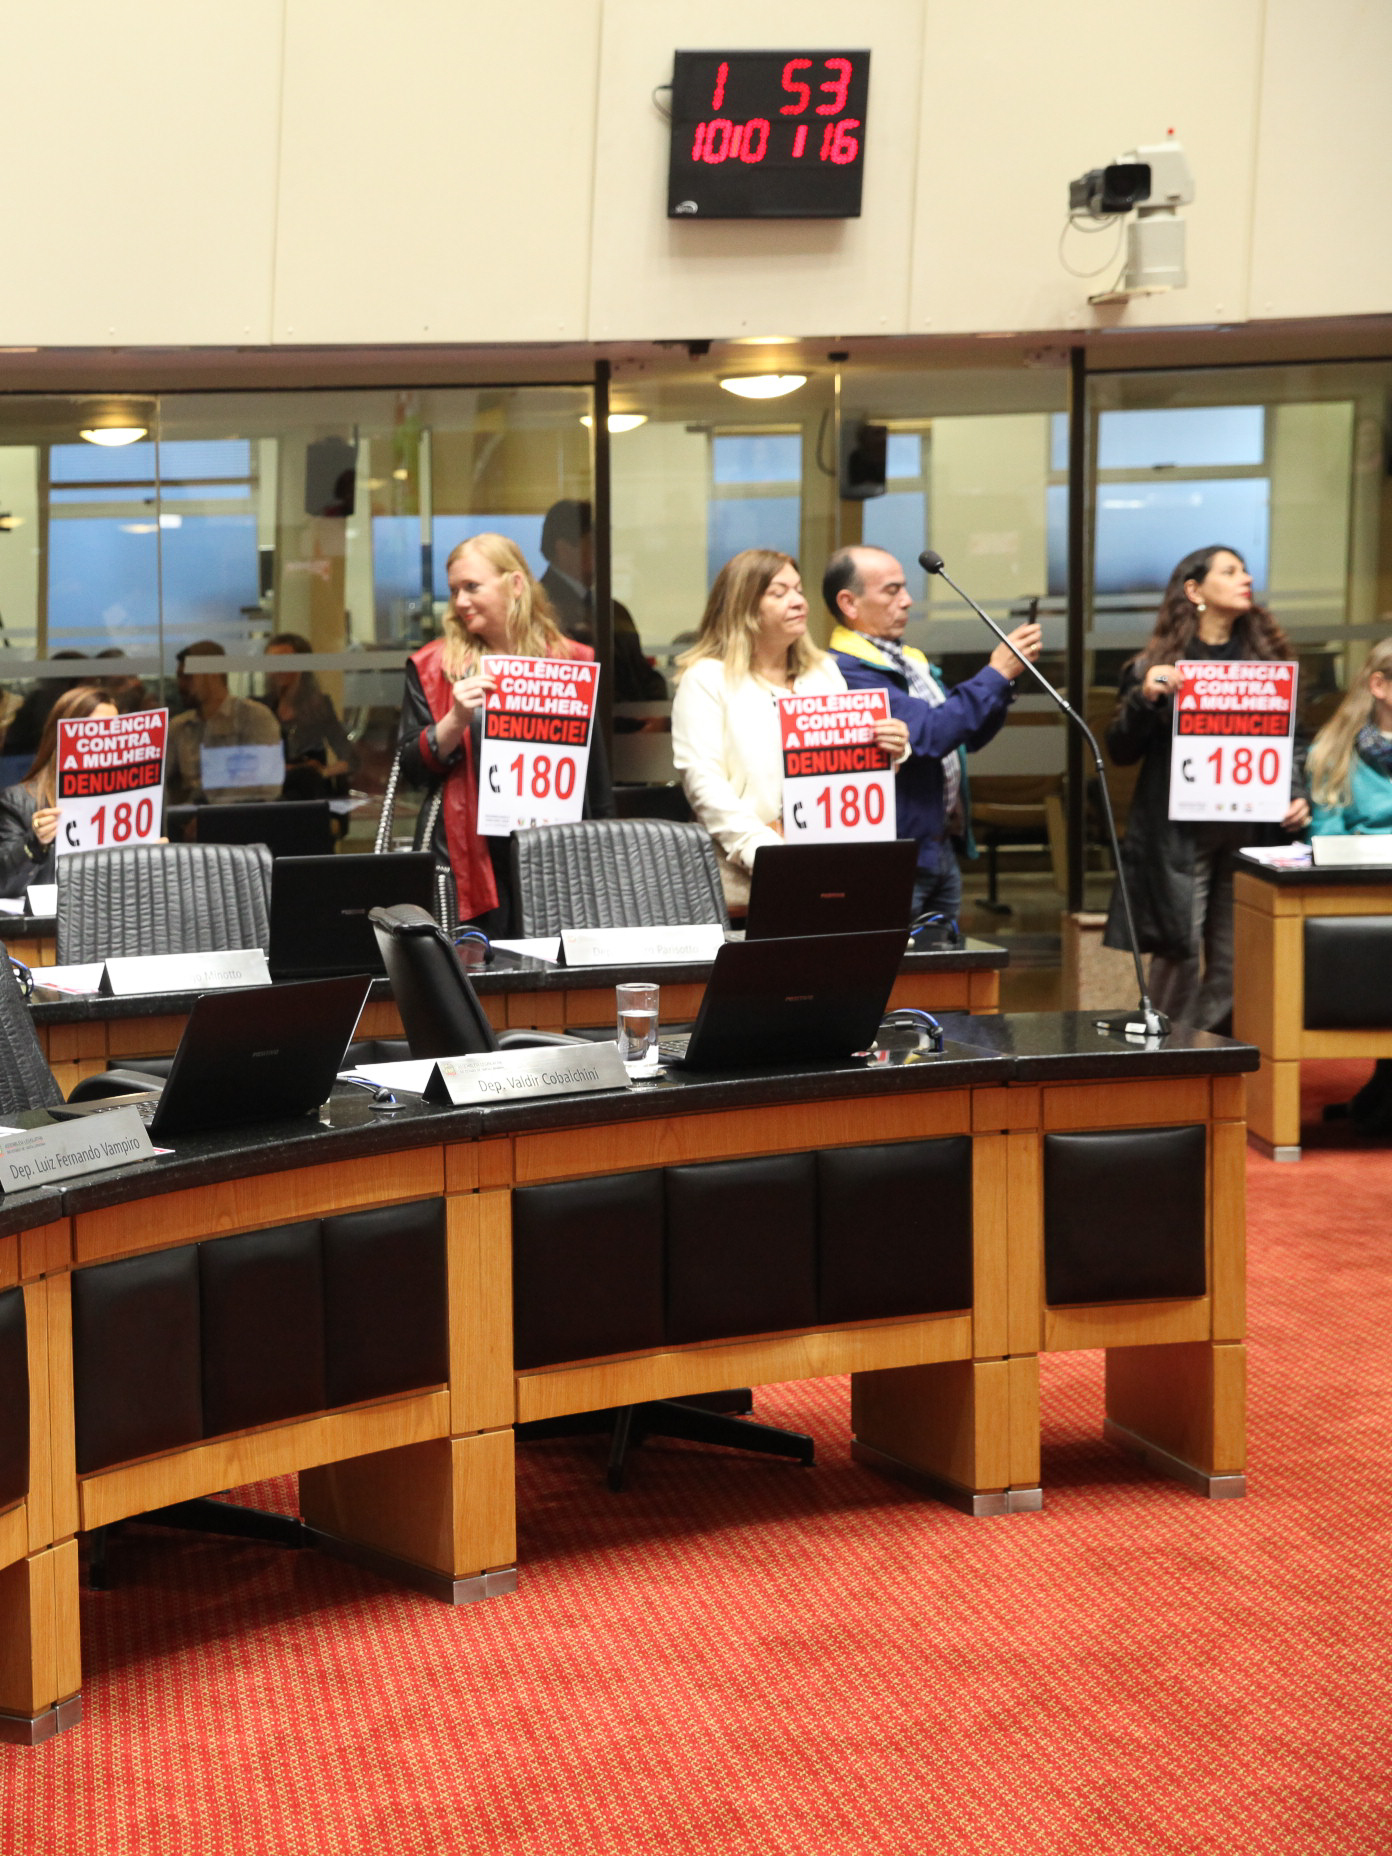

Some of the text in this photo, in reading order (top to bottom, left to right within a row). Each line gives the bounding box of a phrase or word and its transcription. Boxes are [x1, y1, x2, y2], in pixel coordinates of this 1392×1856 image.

[779, 57, 853, 116] 53
[488, 660, 592, 683] VIOLÊNCIA
[1181, 662, 1291, 681] VIOLÊNCIA
[500, 679, 577, 698] CONTRA
[1193, 680, 1277, 696] CONTRA
[487, 694, 589, 716] A MULHER:
[781, 693, 885, 715] VIOLÊNCIA
[1180, 695, 1289, 712] A MULHER:
[64, 714, 163, 738] VIOLÊNCIA
[487, 714, 587, 744] DENUNCIE!
[795, 710, 875, 731] CONTRA
[1179, 712, 1288, 736] DENUNCIE!
[76, 731, 151, 753] CONTRA
[785, 732, 801, 748] A
[63, 745, 161, 770] A MULHER:
[786, 746, 888, 776] DENUNCIE!
[1208, 747, 1280, 786] 180
[63, 763, 159, 796] DENUNCIE!
[510, 753, 576, 800] 180
[816, 782, 885, 829] 180
[90, 797, 153, 846] 180
[478, 1067, 600, 1094] Dep. Valdir Cobalchini
[9, 1137, 141, 1180] Dep. Luiz Fernando Vampiro
